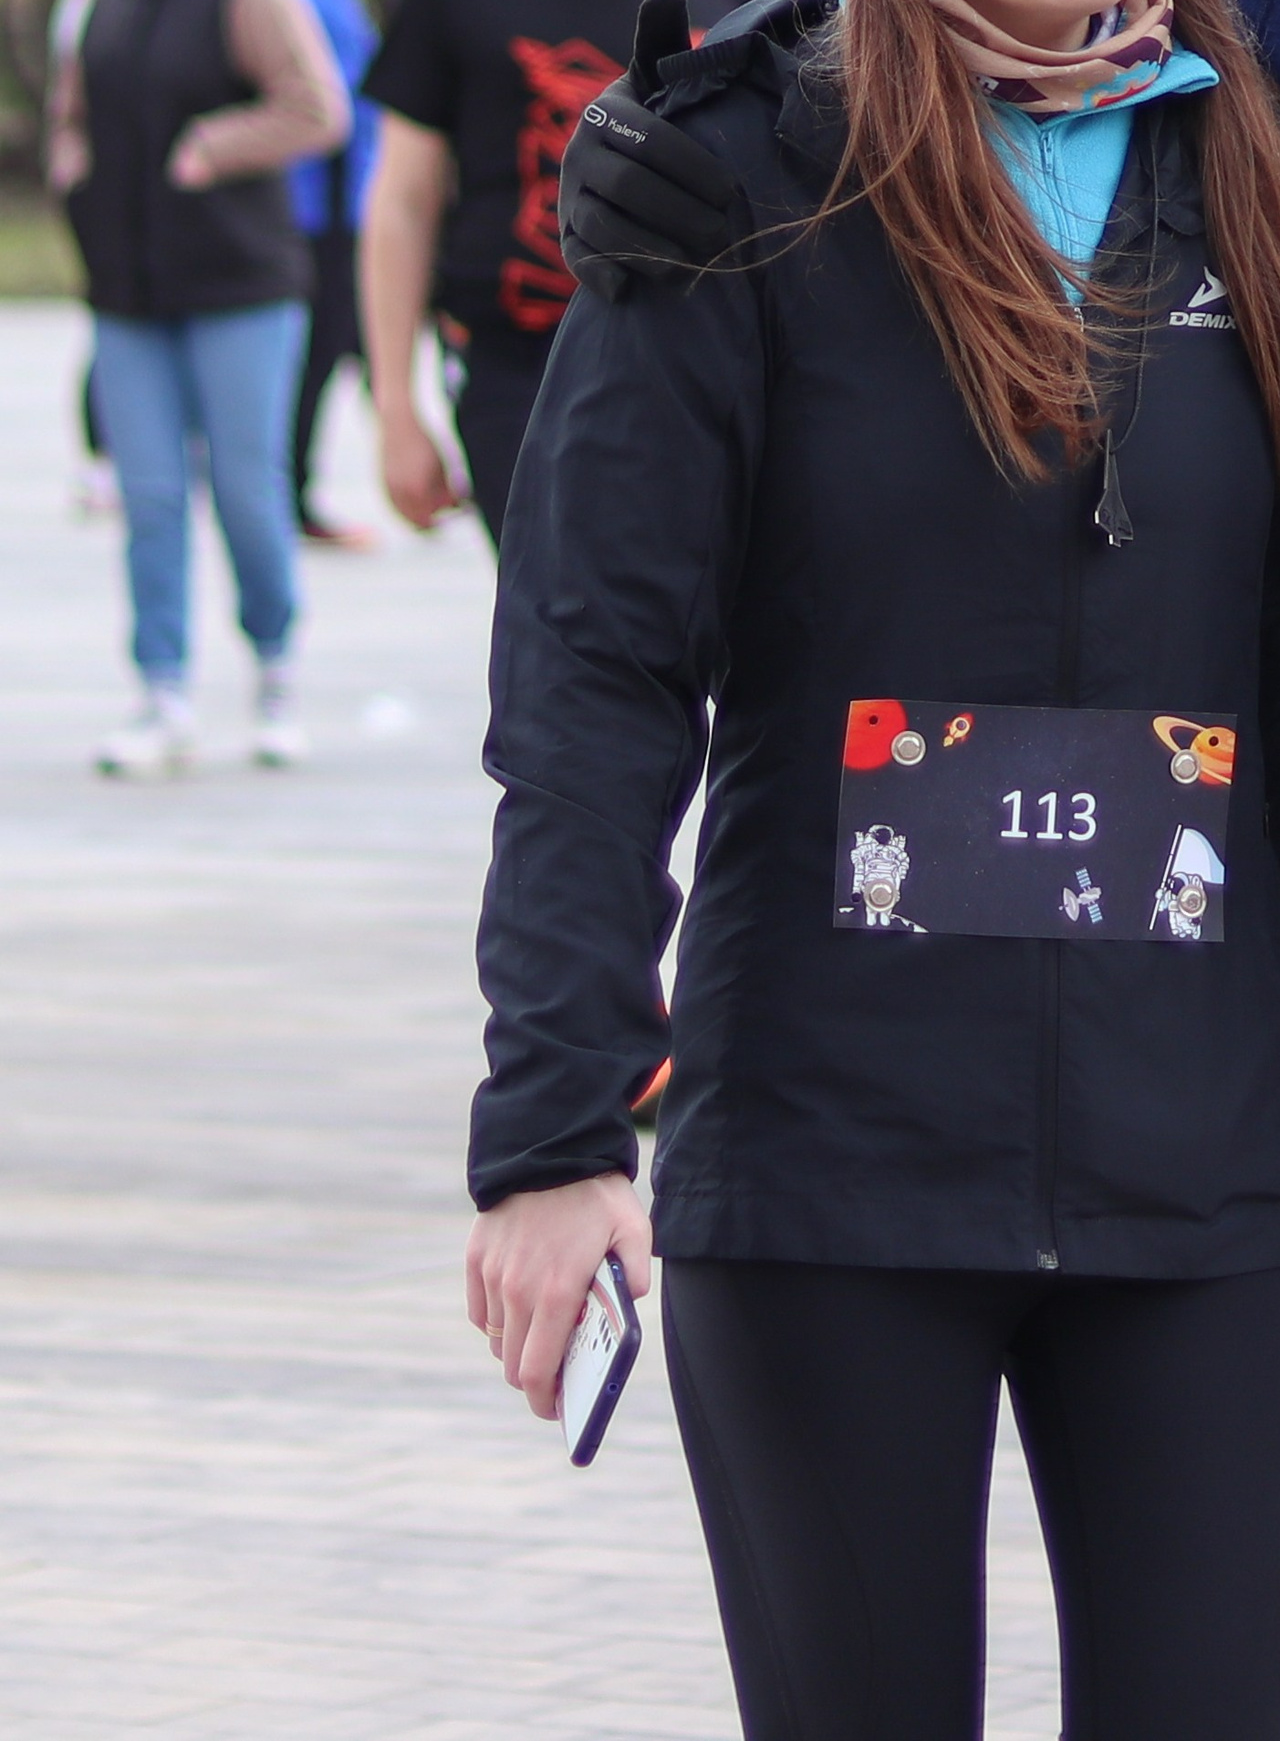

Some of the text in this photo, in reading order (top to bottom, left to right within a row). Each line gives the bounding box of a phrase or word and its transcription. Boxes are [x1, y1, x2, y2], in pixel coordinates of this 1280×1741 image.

[608, 117, 649, 144] Kalenji
[1169, 311, 1237, 329] DEMIX
[1000, 789, 1098, 841] 113
